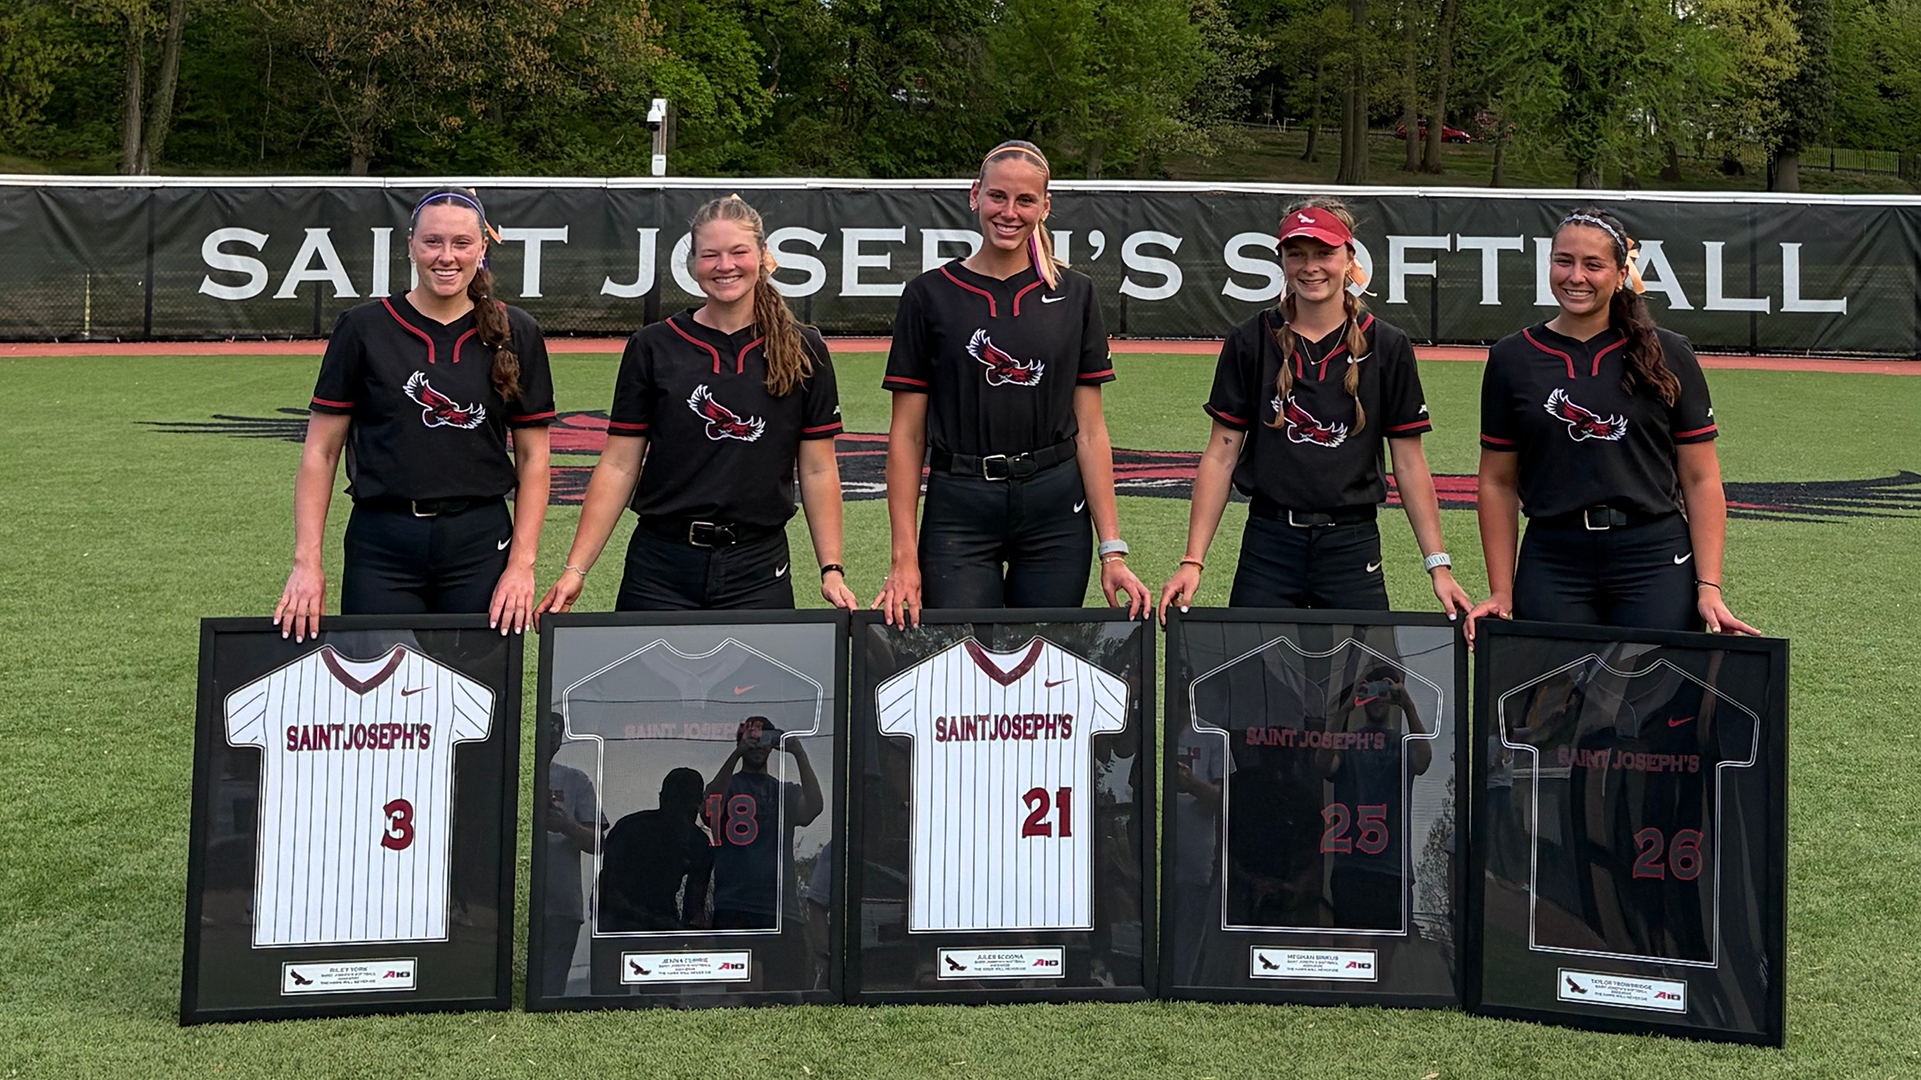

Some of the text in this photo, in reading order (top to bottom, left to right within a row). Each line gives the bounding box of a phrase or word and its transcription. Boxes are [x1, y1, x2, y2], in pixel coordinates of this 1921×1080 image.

[198, 225, 569, 300] SAIT
[286, 722, 432, 751] SAINT JOSEPH'S
[624, 722, 677, 739] SAINT
[935, 713, 1073, 742] SAINT JOSEPH'S
[1245, 726, 1386, 750] SAINT JOSEPH'S
[1557, 744, 1701, 773] SAINT JOSEPH'S
[380, 798, 415, 851] 3
[705, 793, 759, 847] 18
[1021, 786, 1073, 839] 21
[1319, 802, 1390, 854] 25
[1632, 826, 1705, 881] 26
